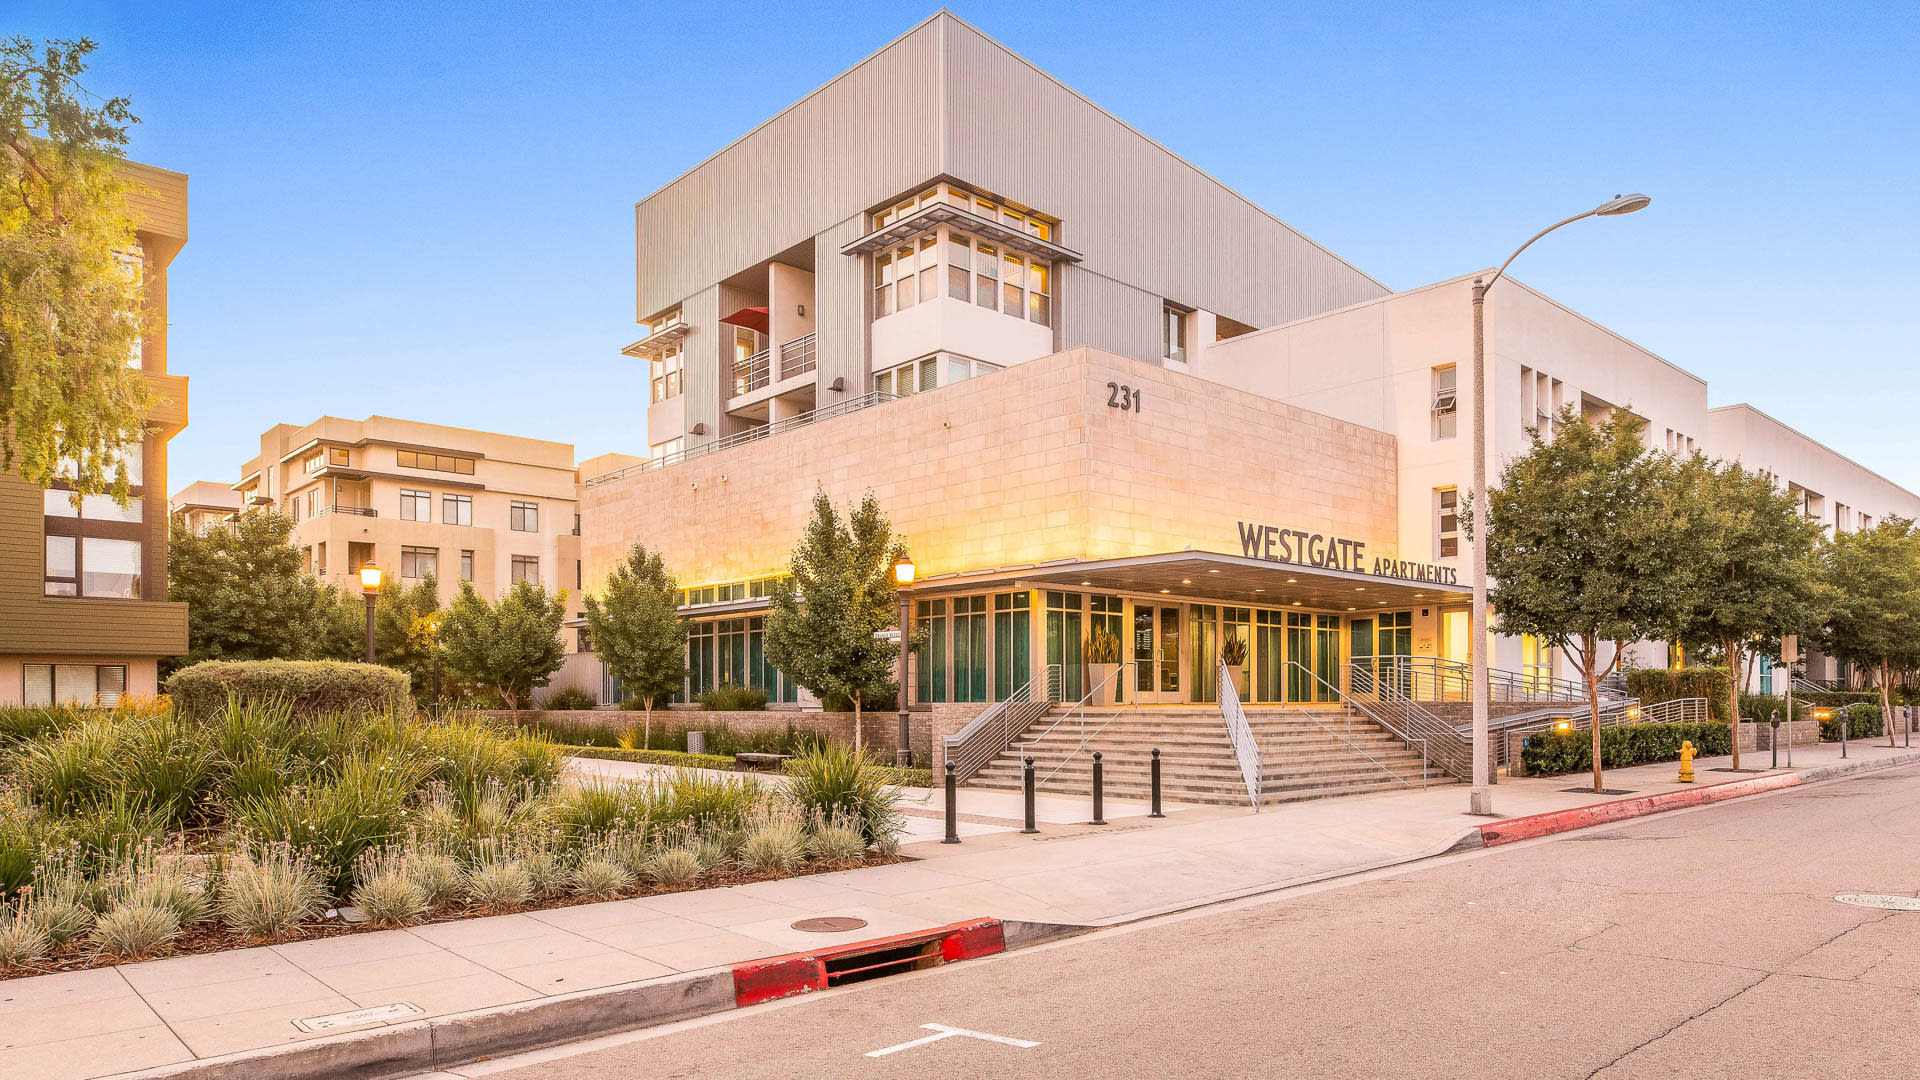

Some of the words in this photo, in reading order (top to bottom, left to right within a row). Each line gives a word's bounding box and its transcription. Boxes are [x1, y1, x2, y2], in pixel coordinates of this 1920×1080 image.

[1107, 382, 1140, 413] 231
[1238, 521, 1365, 573] WESTGATE
[1373, 556, 1456, 585] APARTMENTS
